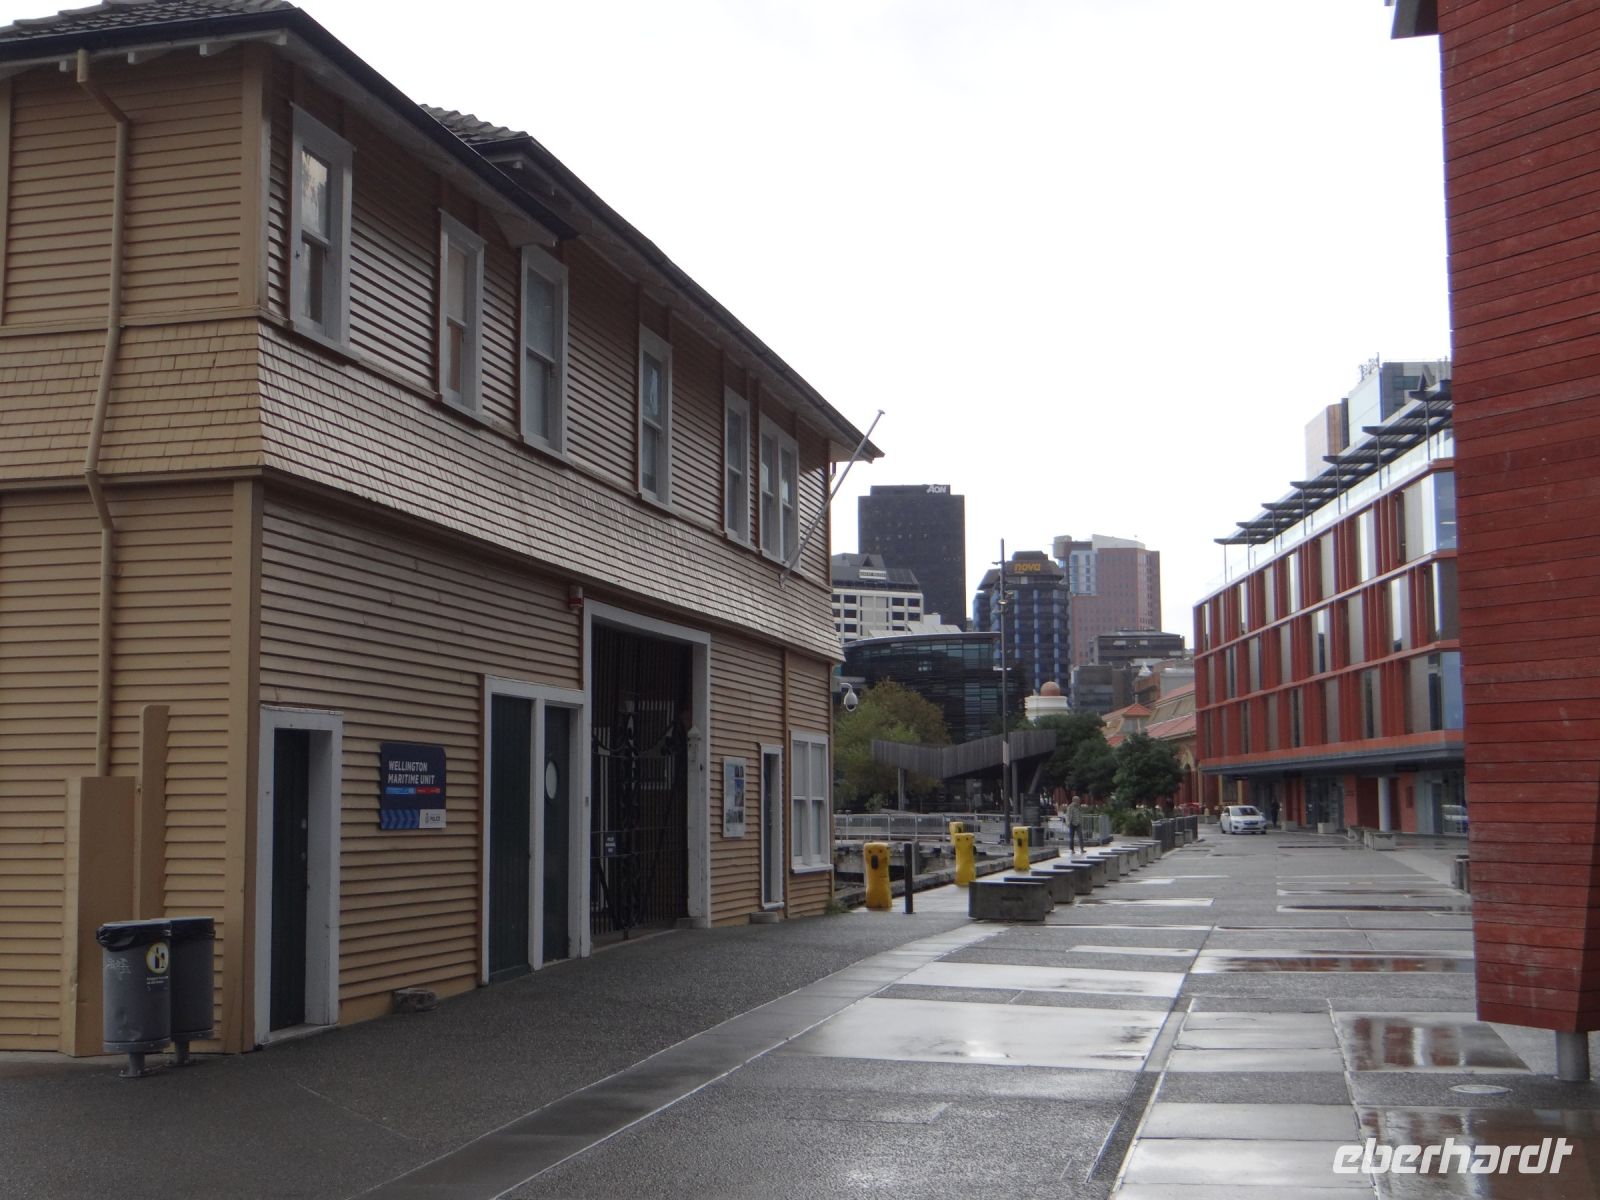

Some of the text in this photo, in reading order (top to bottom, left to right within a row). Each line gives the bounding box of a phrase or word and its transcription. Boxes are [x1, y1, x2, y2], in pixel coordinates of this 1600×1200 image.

[926, 484, 947, 494] AON
[1014, 562, 1041, 573] nova
[388, 760, 428, 772] WELLINGTON
[387, 773, 435, 785] MARITIME UNIT
